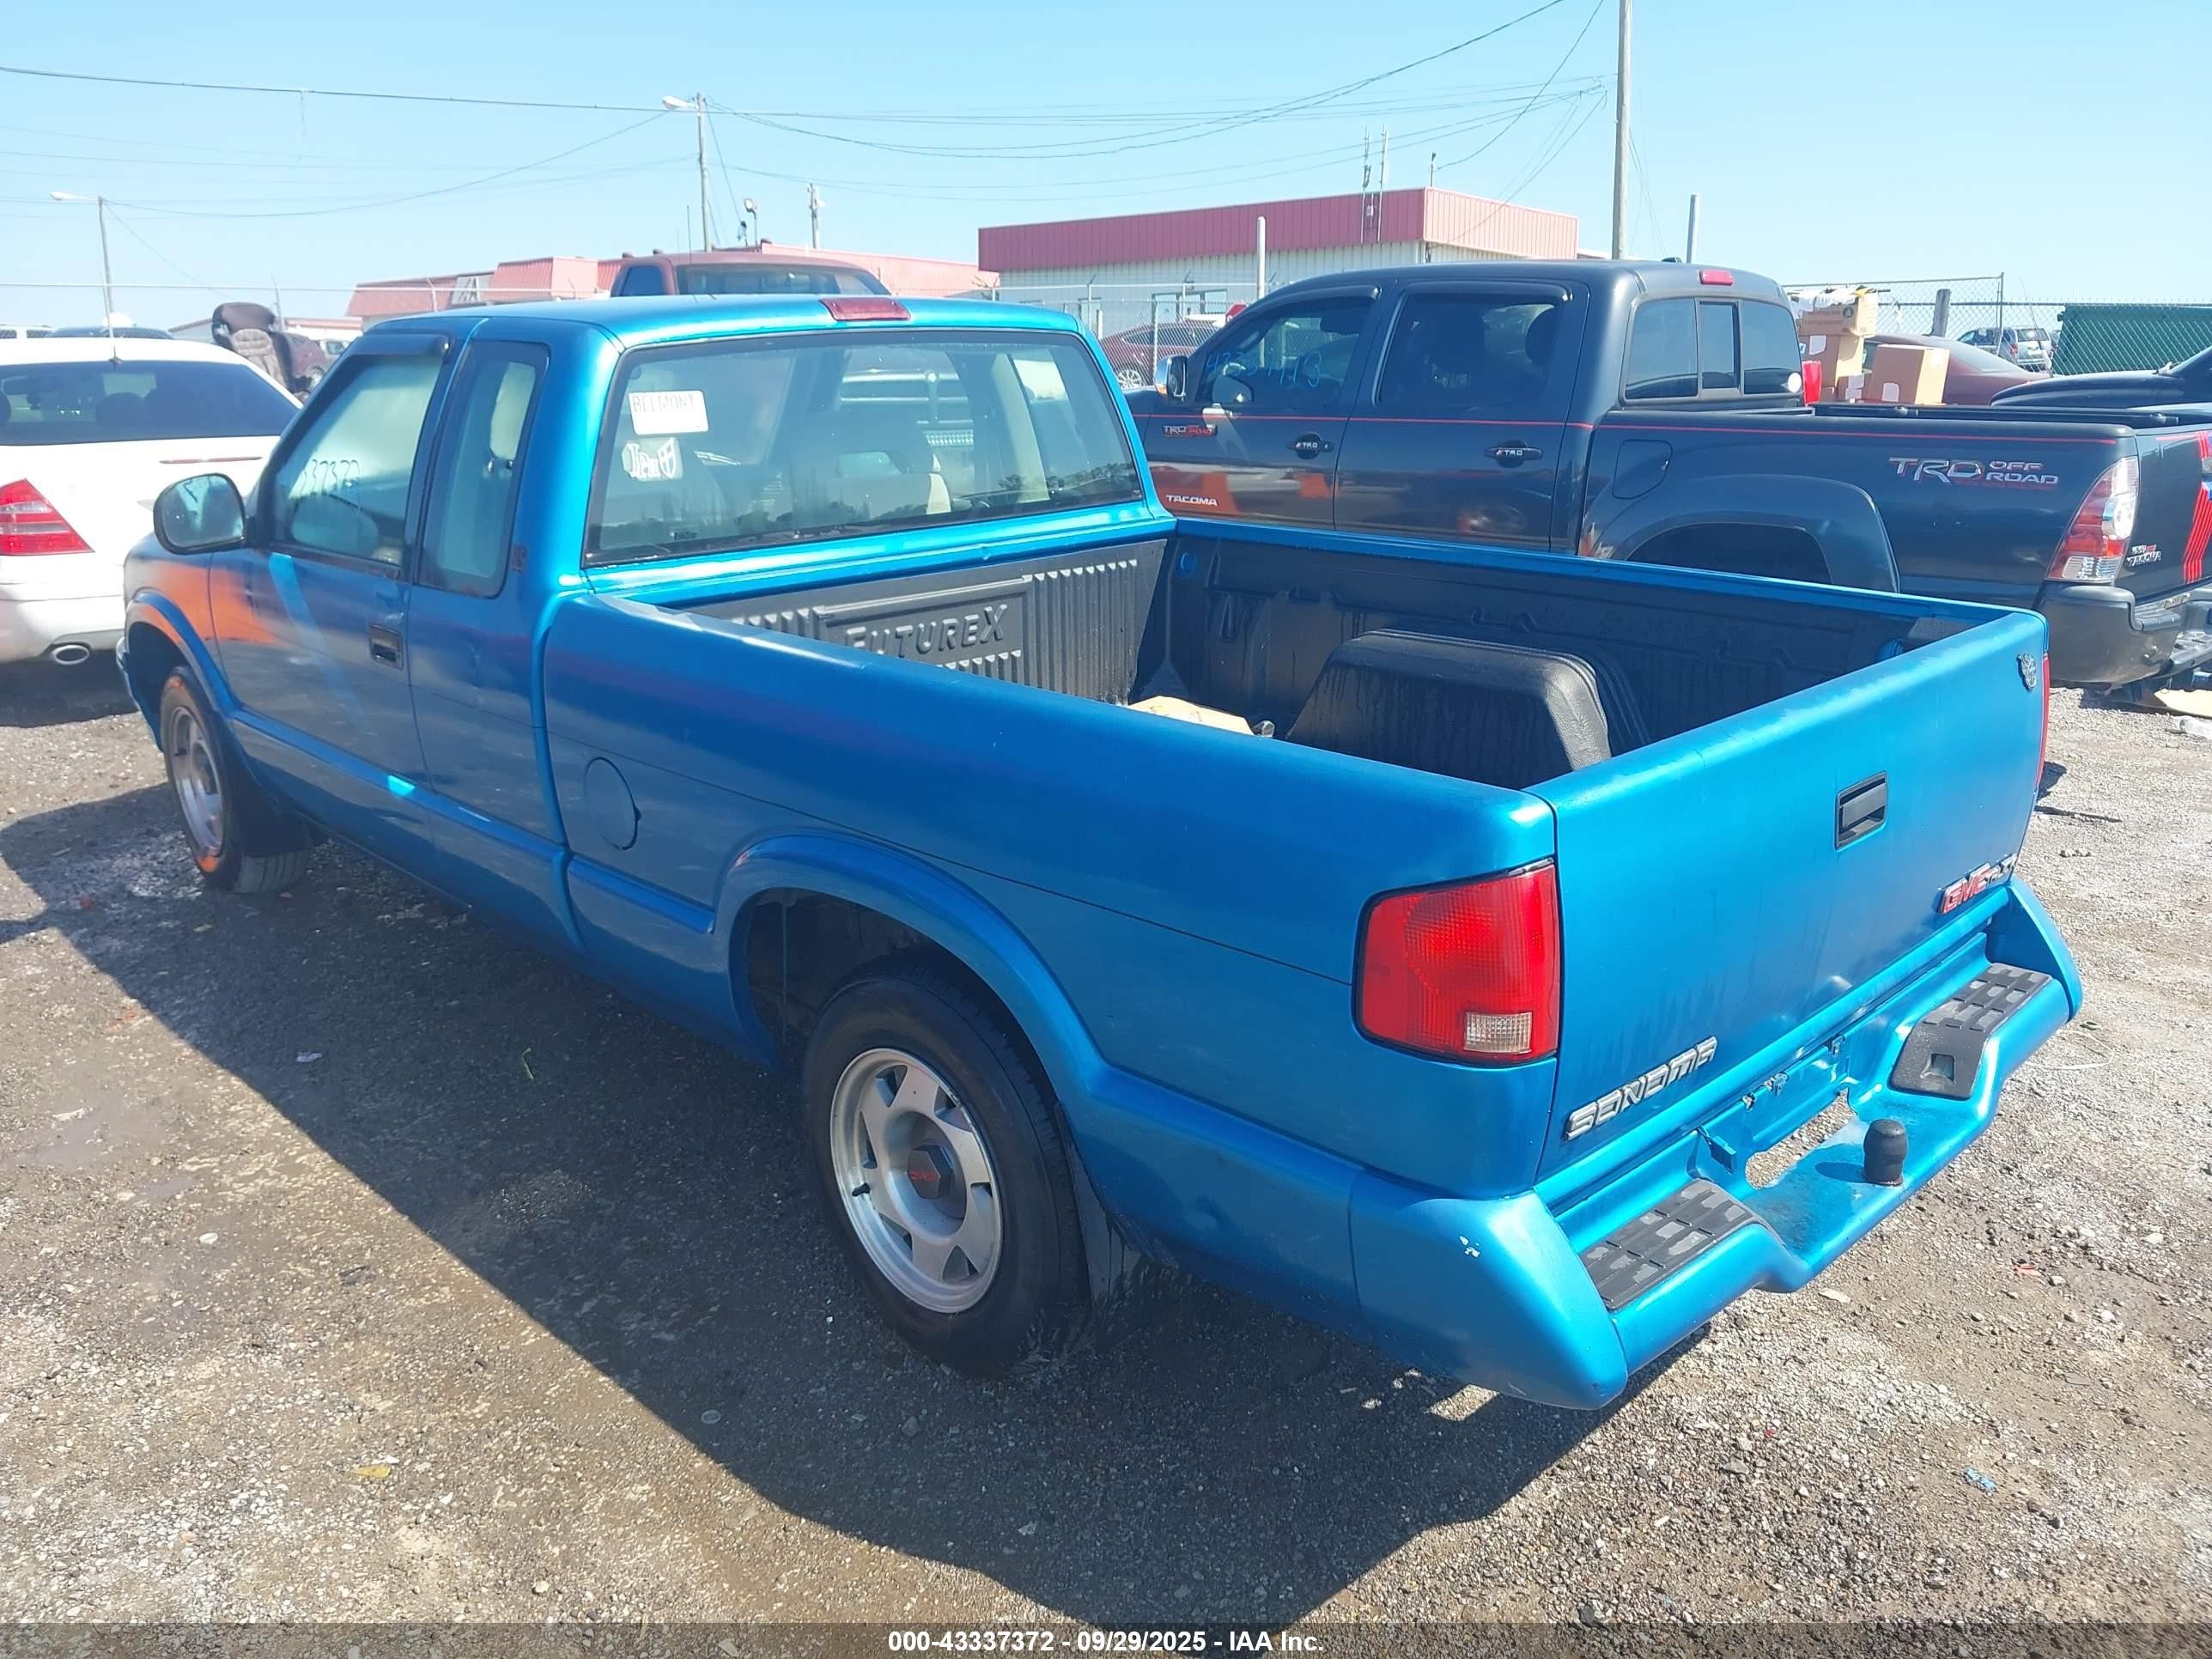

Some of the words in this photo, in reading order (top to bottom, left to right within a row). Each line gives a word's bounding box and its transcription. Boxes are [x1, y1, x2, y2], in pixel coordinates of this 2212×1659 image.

[1888, 457, 1984, 483] TRD
[1986, 471, 2059, 485] ROAD
[1989, 460, 2044, 471] OFF
[1165, 495, 1218, 507] TACOMA
[844, 604, 1008, 659] FUTUREX
[1942, 863, 1990, 915] GMC
[1565, 1036, 1717, 1141] SONOMA
